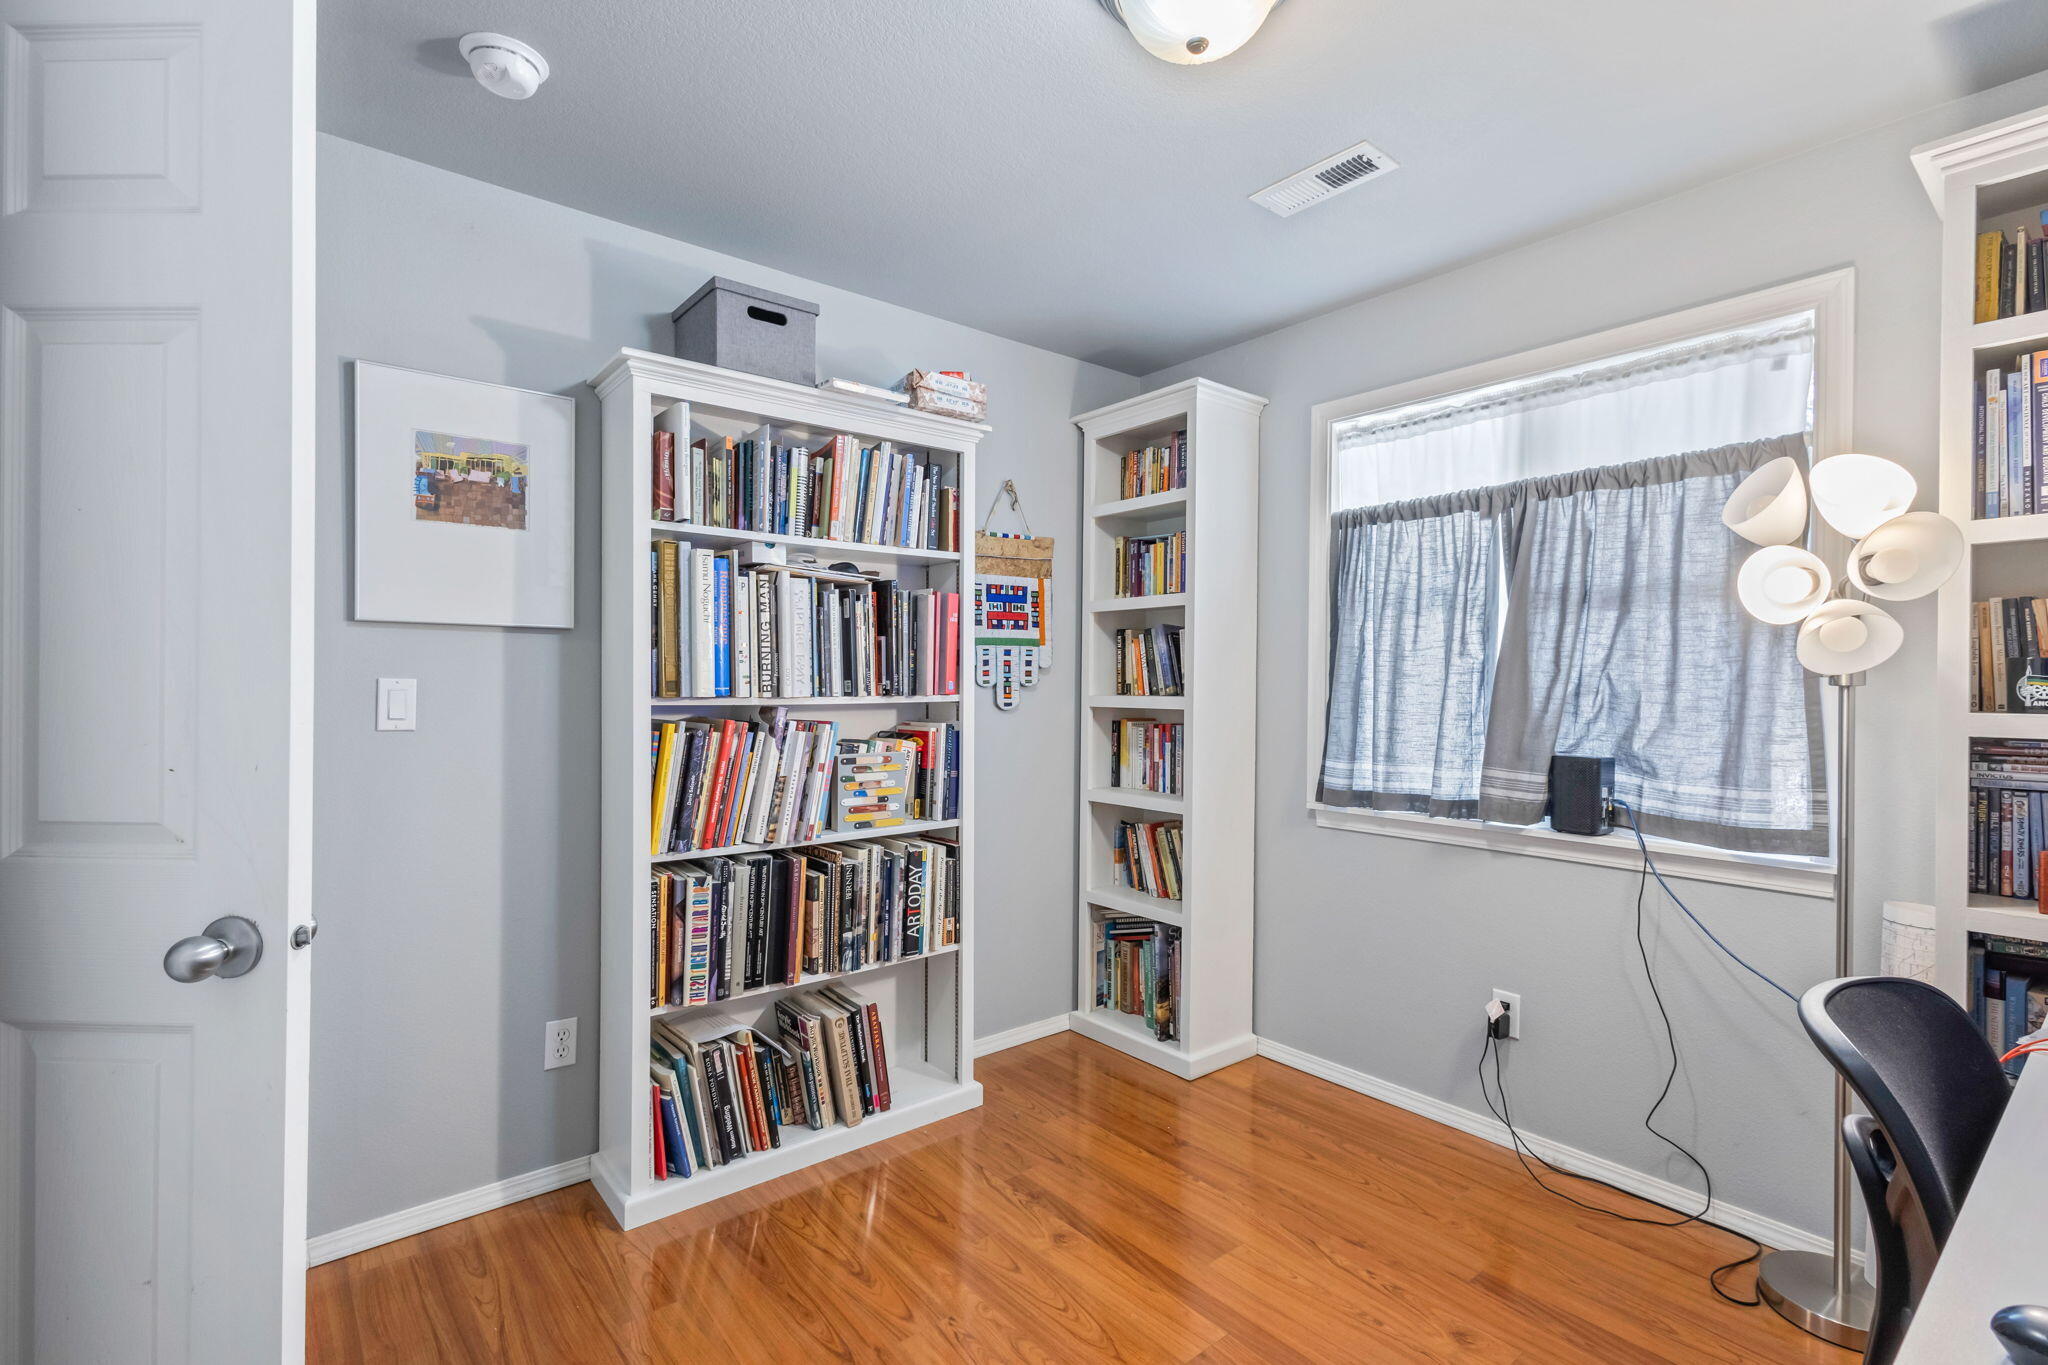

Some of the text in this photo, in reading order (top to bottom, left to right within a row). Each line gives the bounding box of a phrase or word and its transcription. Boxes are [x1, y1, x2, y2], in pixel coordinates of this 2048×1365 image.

[2023, 470, 2031, 509] MARZANO
[701, 554, 713, 624] Isamu Noguchi
[718, 570, 730, 645] Romanesque
[759, 579, 773, 693] BURNING MAN
[688, 775, 696, 793] Salcedo
[1978, 800, 1987, 822] Paljas
[1990, 811, 1999, 829] BILL
[845, 864, 853, 900] BERNINI
[906, 864, 922, 937] ARTODAY
[857, 1023, 865, 1050] Workbench
[813, 1047, 822, 1078] Workbook
[838, 1031, 853, 1087] THAI SCULPTURE
[704, 1057, 719, 1110] RONA PONDICK
[752, 1084, 760, 1108] YANKEE
[723, 1105, 737, 1149] Modern Welding
